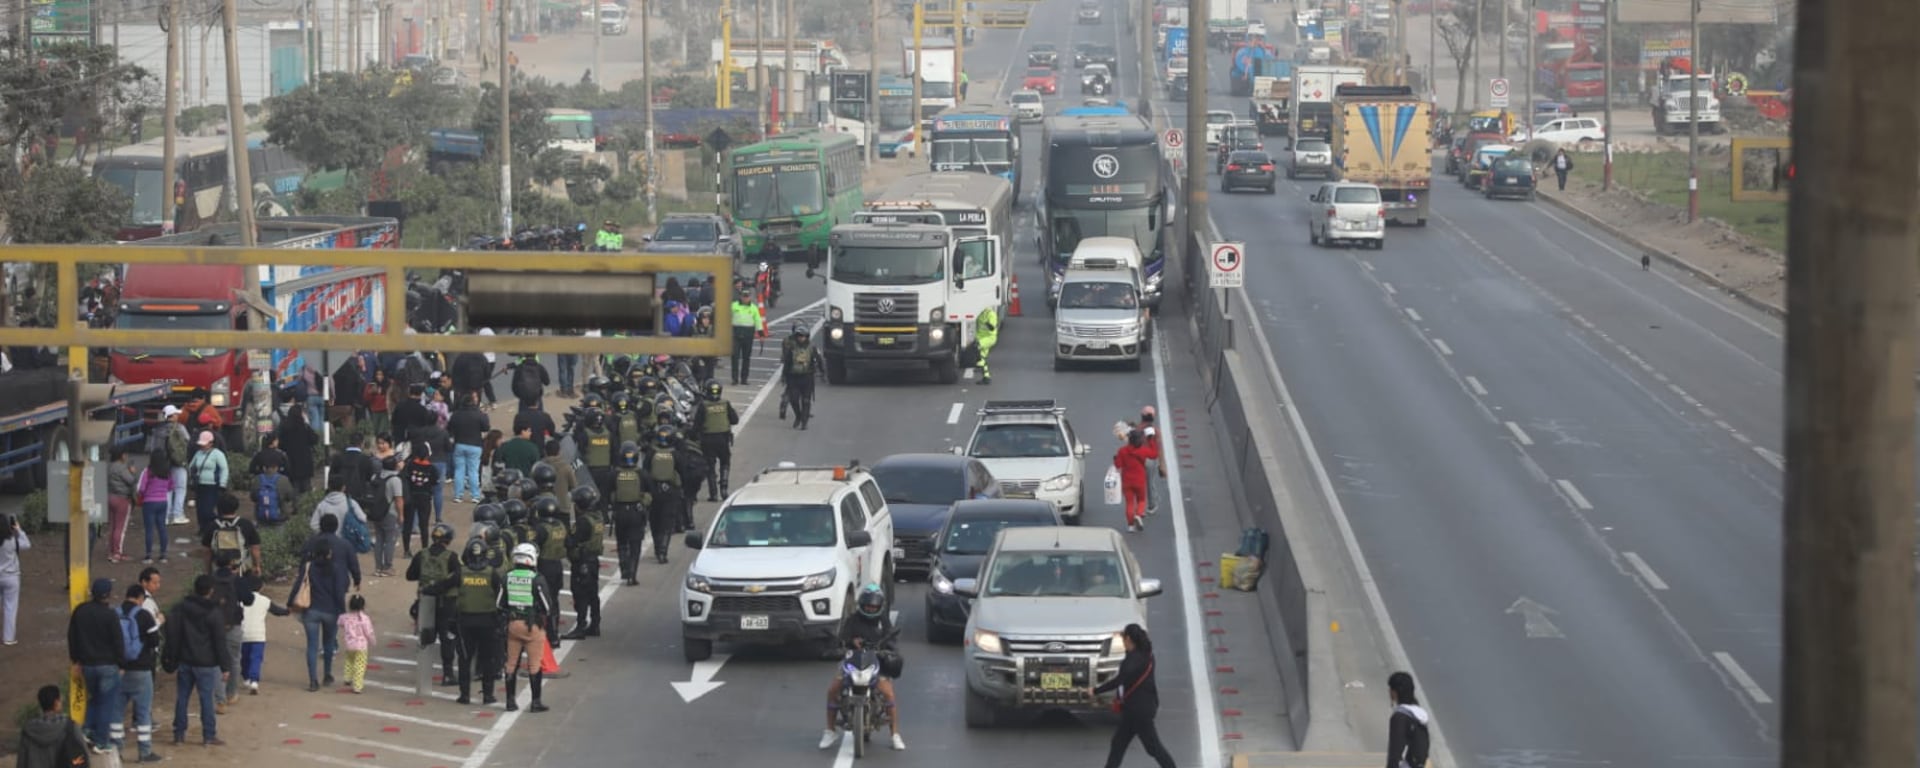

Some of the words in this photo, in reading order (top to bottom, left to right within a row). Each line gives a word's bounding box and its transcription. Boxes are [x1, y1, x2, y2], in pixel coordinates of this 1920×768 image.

[959, 212, 967, 222] LA
[968, 212, 985, 222] PERLA
[462, 577, 488, 587] POLICIA
